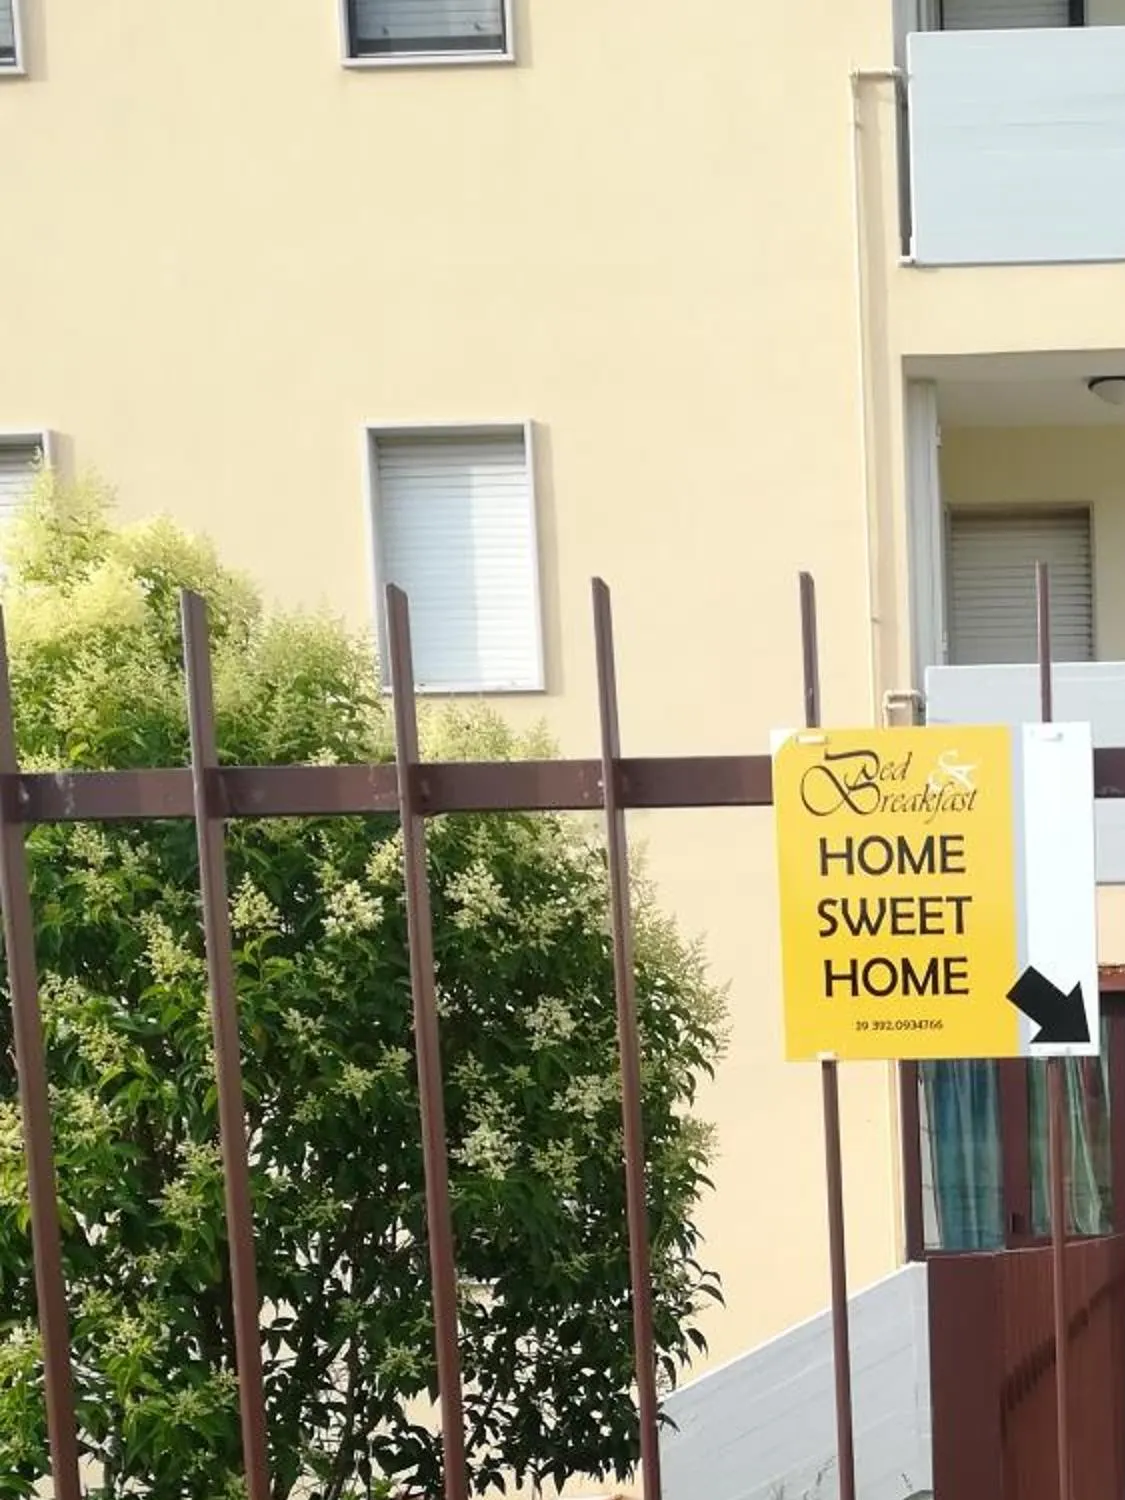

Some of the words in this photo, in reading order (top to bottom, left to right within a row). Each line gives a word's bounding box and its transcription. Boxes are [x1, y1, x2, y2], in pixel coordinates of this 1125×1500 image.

[815, 749, 913, 795] Bed
[801, 765, 977, 824] Breakfast
[819, 834, 967, 876] HOME
[817, 895, 973, 937] SWEET
[824, 956, 970, 997] HOME
